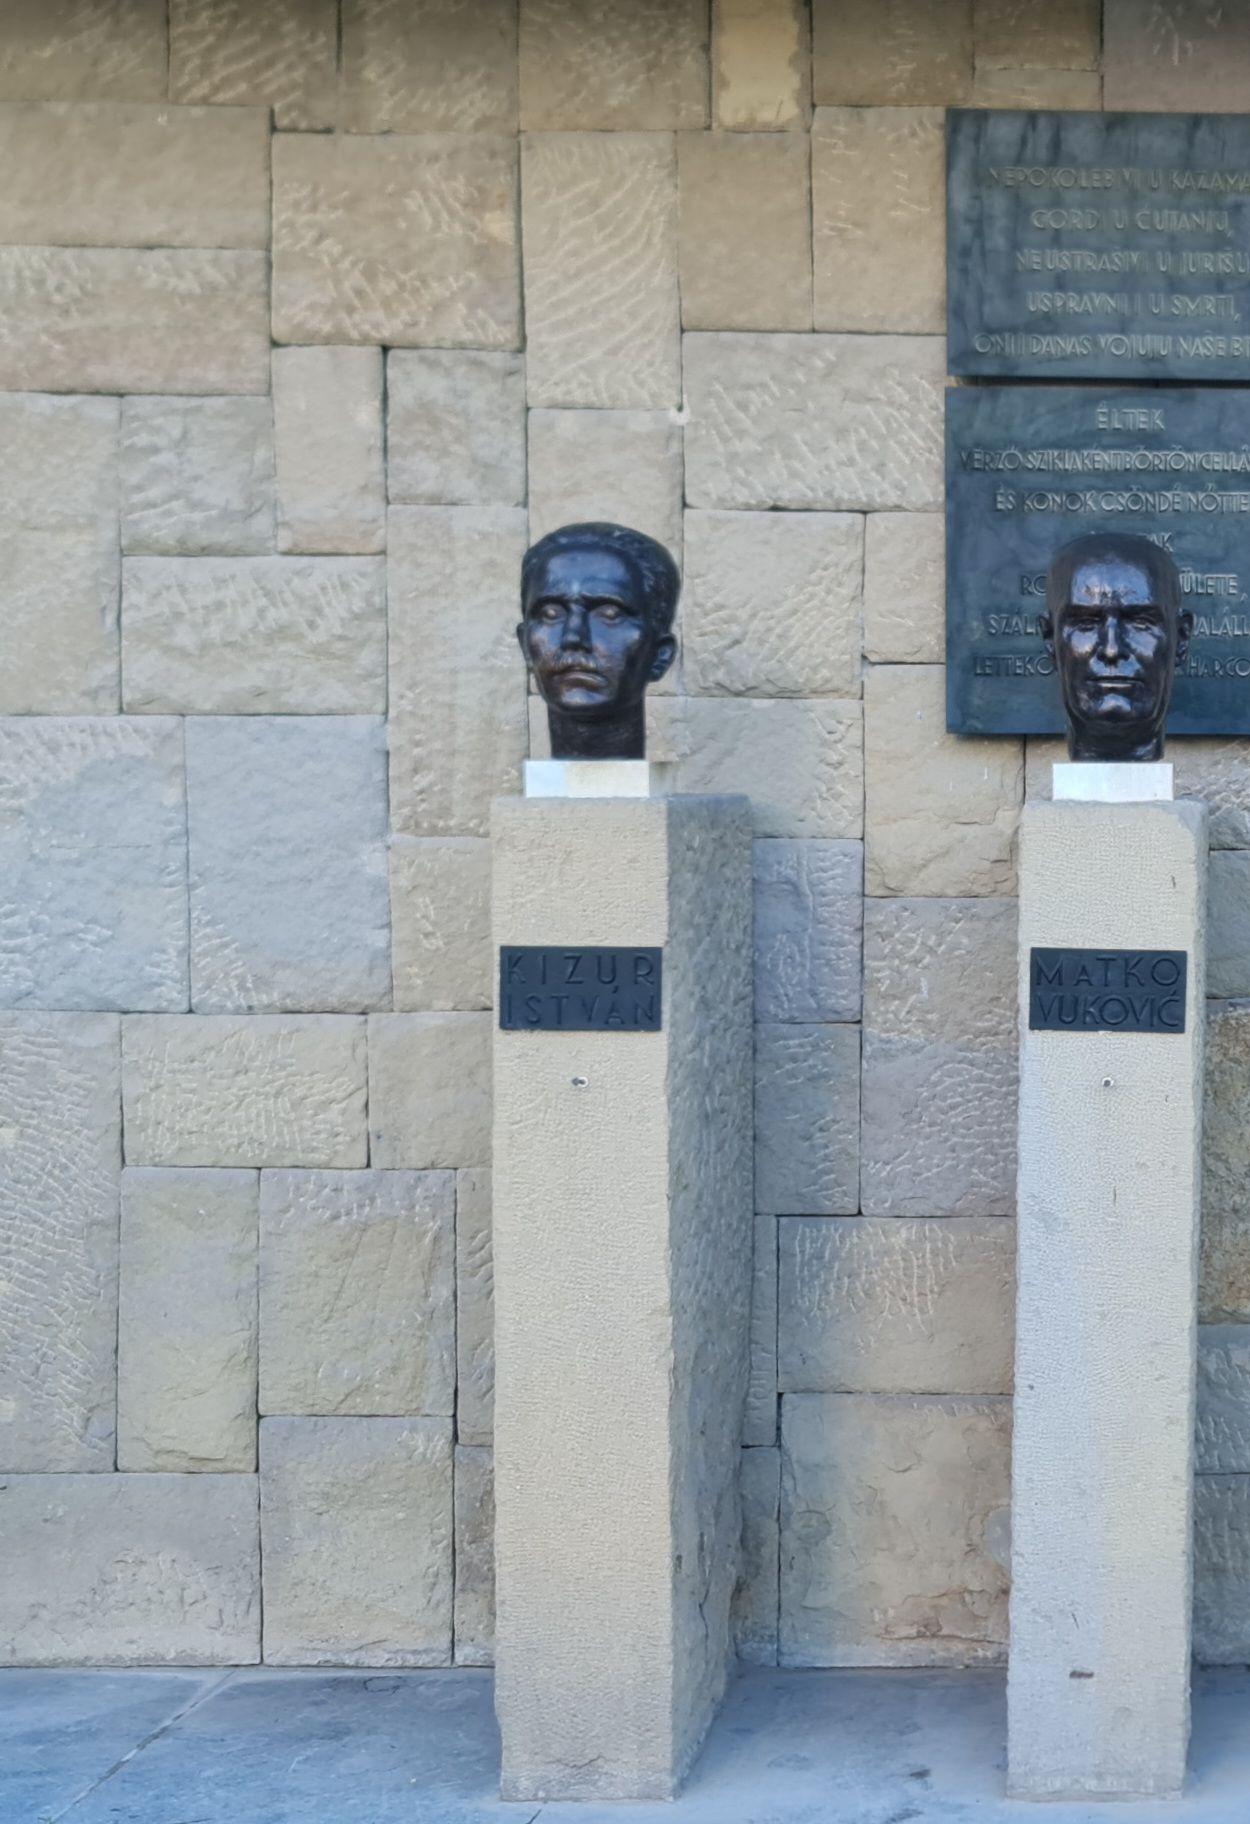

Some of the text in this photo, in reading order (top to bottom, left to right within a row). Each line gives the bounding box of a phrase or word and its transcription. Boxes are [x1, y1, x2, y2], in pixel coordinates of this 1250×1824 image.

[1151, 168, 1162, 189] U
[1112, 209, 1128, 230] U
[1158, 251, 1171, 273] U
[1150, 293, 1163, 315] U
[1030, 334, 1091, 357] DANAS
[1177, 330, 1226, 358] NAŠE
[1096, 401, 1166, 432] ÉLTEK
[995, 483, 1017, 512] ÉS
[1023, 489, 1098, 513] KONOK
[506, 954, 656, 986] KIZUR
[1035, 955, 1181, 988] MATKO
[506, 985, 656, 1025] ISTVÁN
[1037, 989, 1181, 1028] VUKOVIĆ
